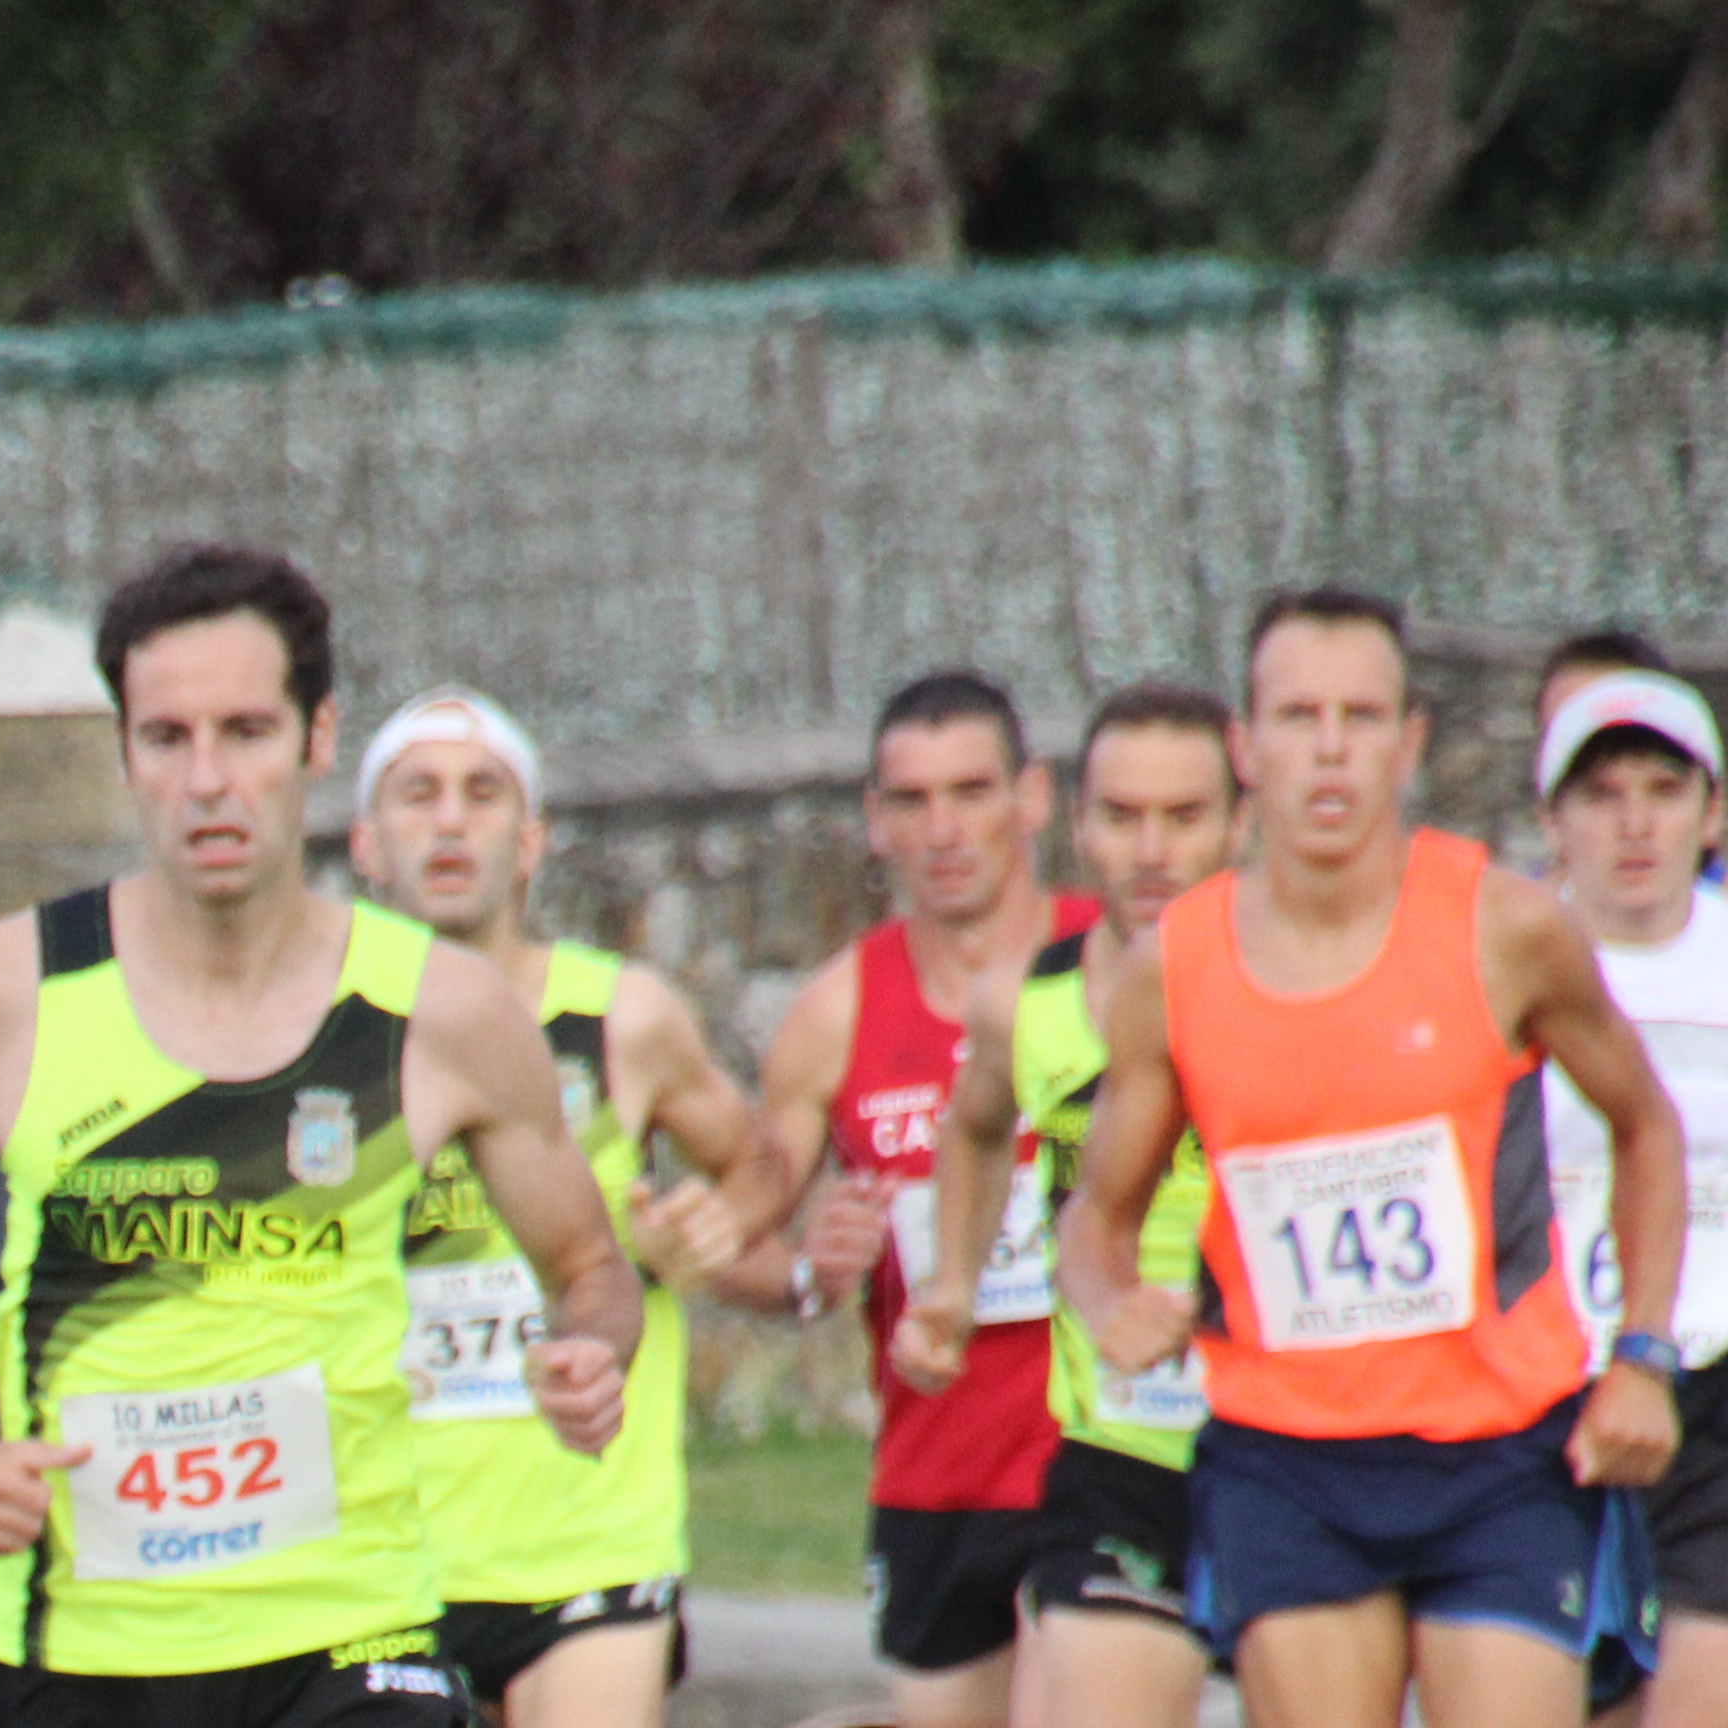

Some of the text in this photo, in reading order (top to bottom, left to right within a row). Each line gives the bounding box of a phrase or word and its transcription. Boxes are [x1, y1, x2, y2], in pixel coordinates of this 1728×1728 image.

[51, 1201, 346, 1263] MAINSA
[1271, 1199, 1434, 1299] 143
[113, 1392, 265, 1431] 10 MILLAS
[115, 1436, 284, 1513] 452
[138, 1522, 264, 1565] correr
